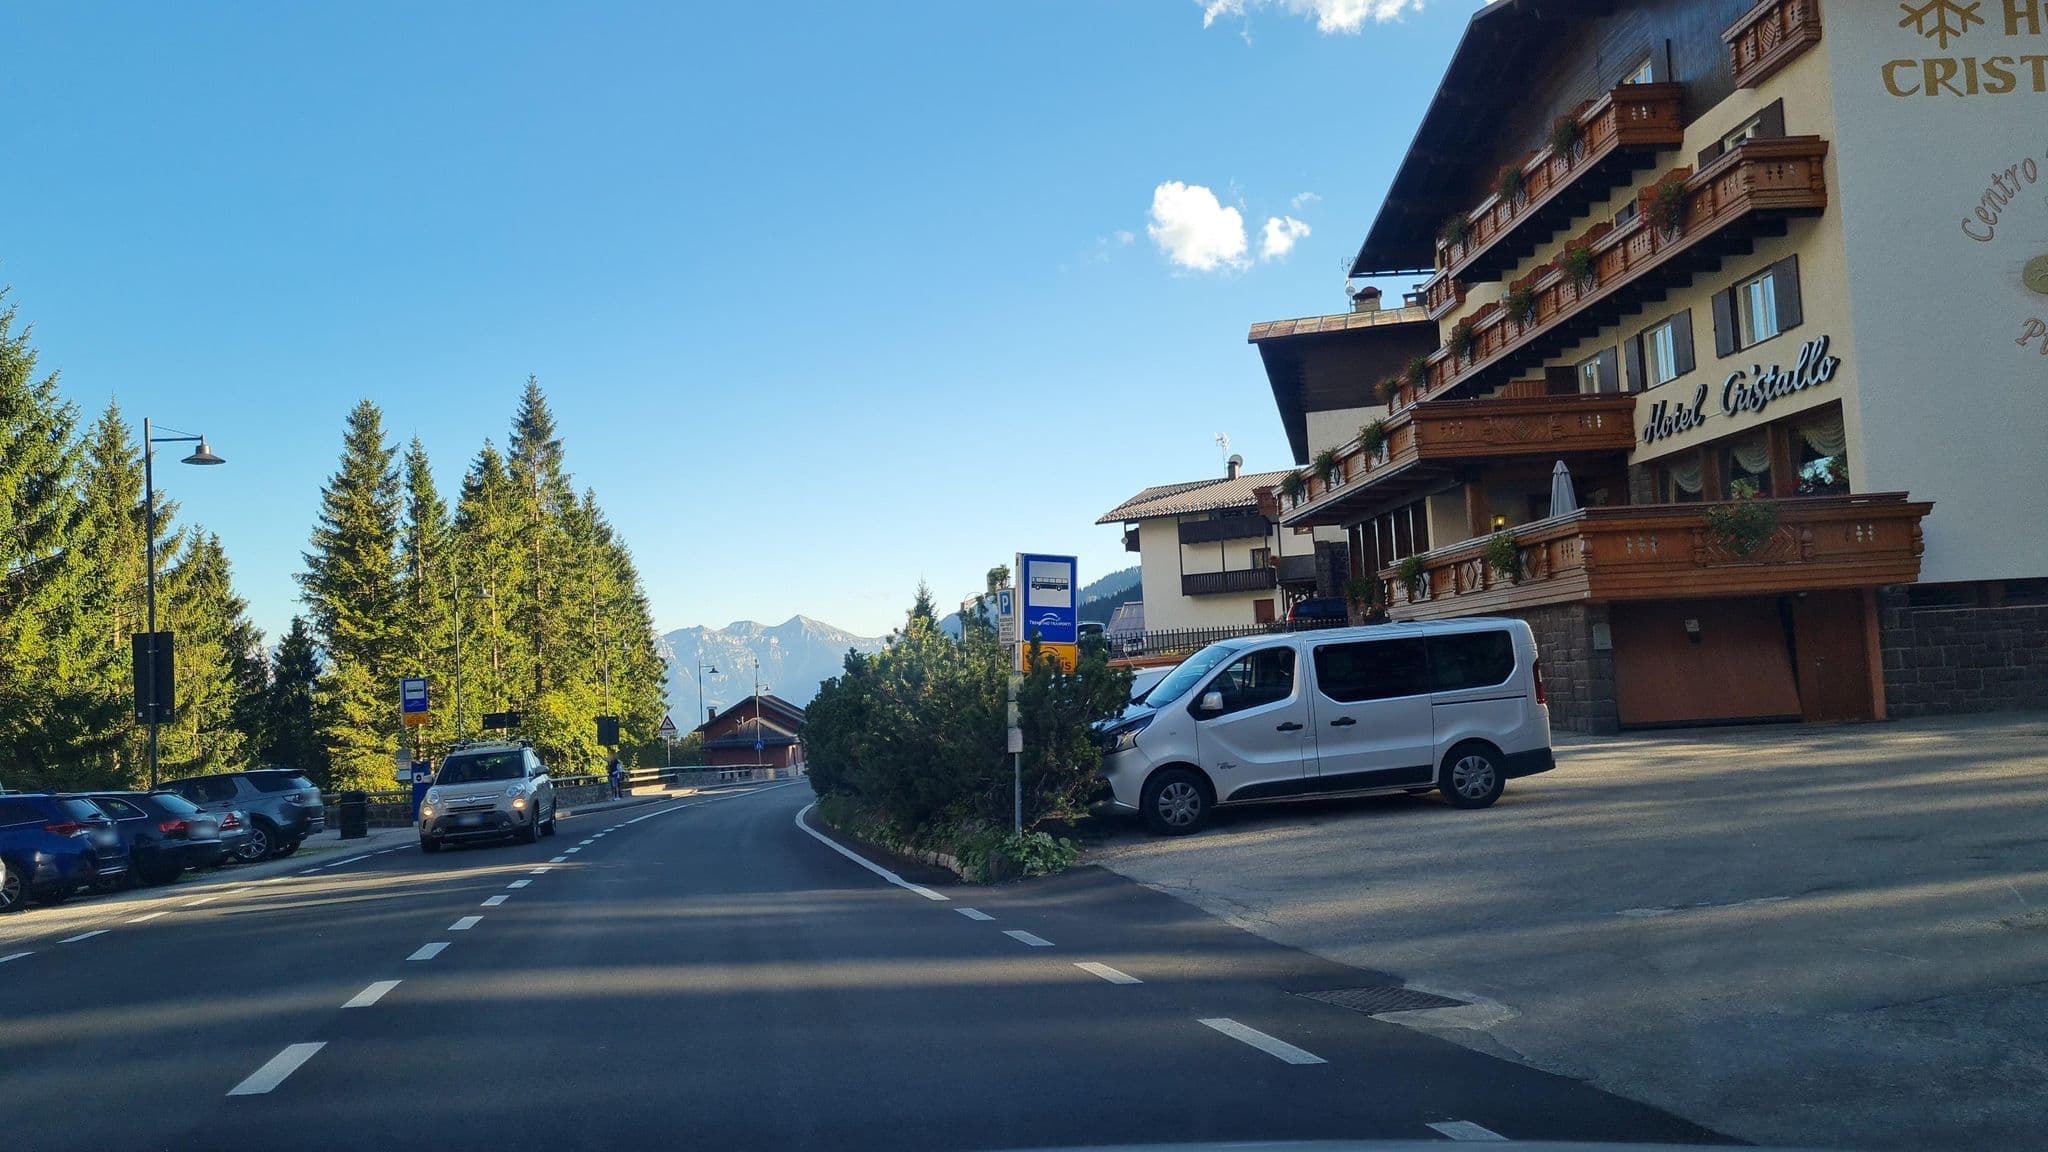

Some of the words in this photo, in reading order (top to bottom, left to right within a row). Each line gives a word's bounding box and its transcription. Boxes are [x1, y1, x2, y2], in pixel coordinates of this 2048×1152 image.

[2003, 0, 2048, 36] H
[1881, 55, 2048, 97] CRIST
[1961, 157, 2038, 242] Centro
[1643, 383, 1708, 444] Hotel
[1720, 334, 1841, 418] Cristallo
[1002, 594, 1009, 613] P
